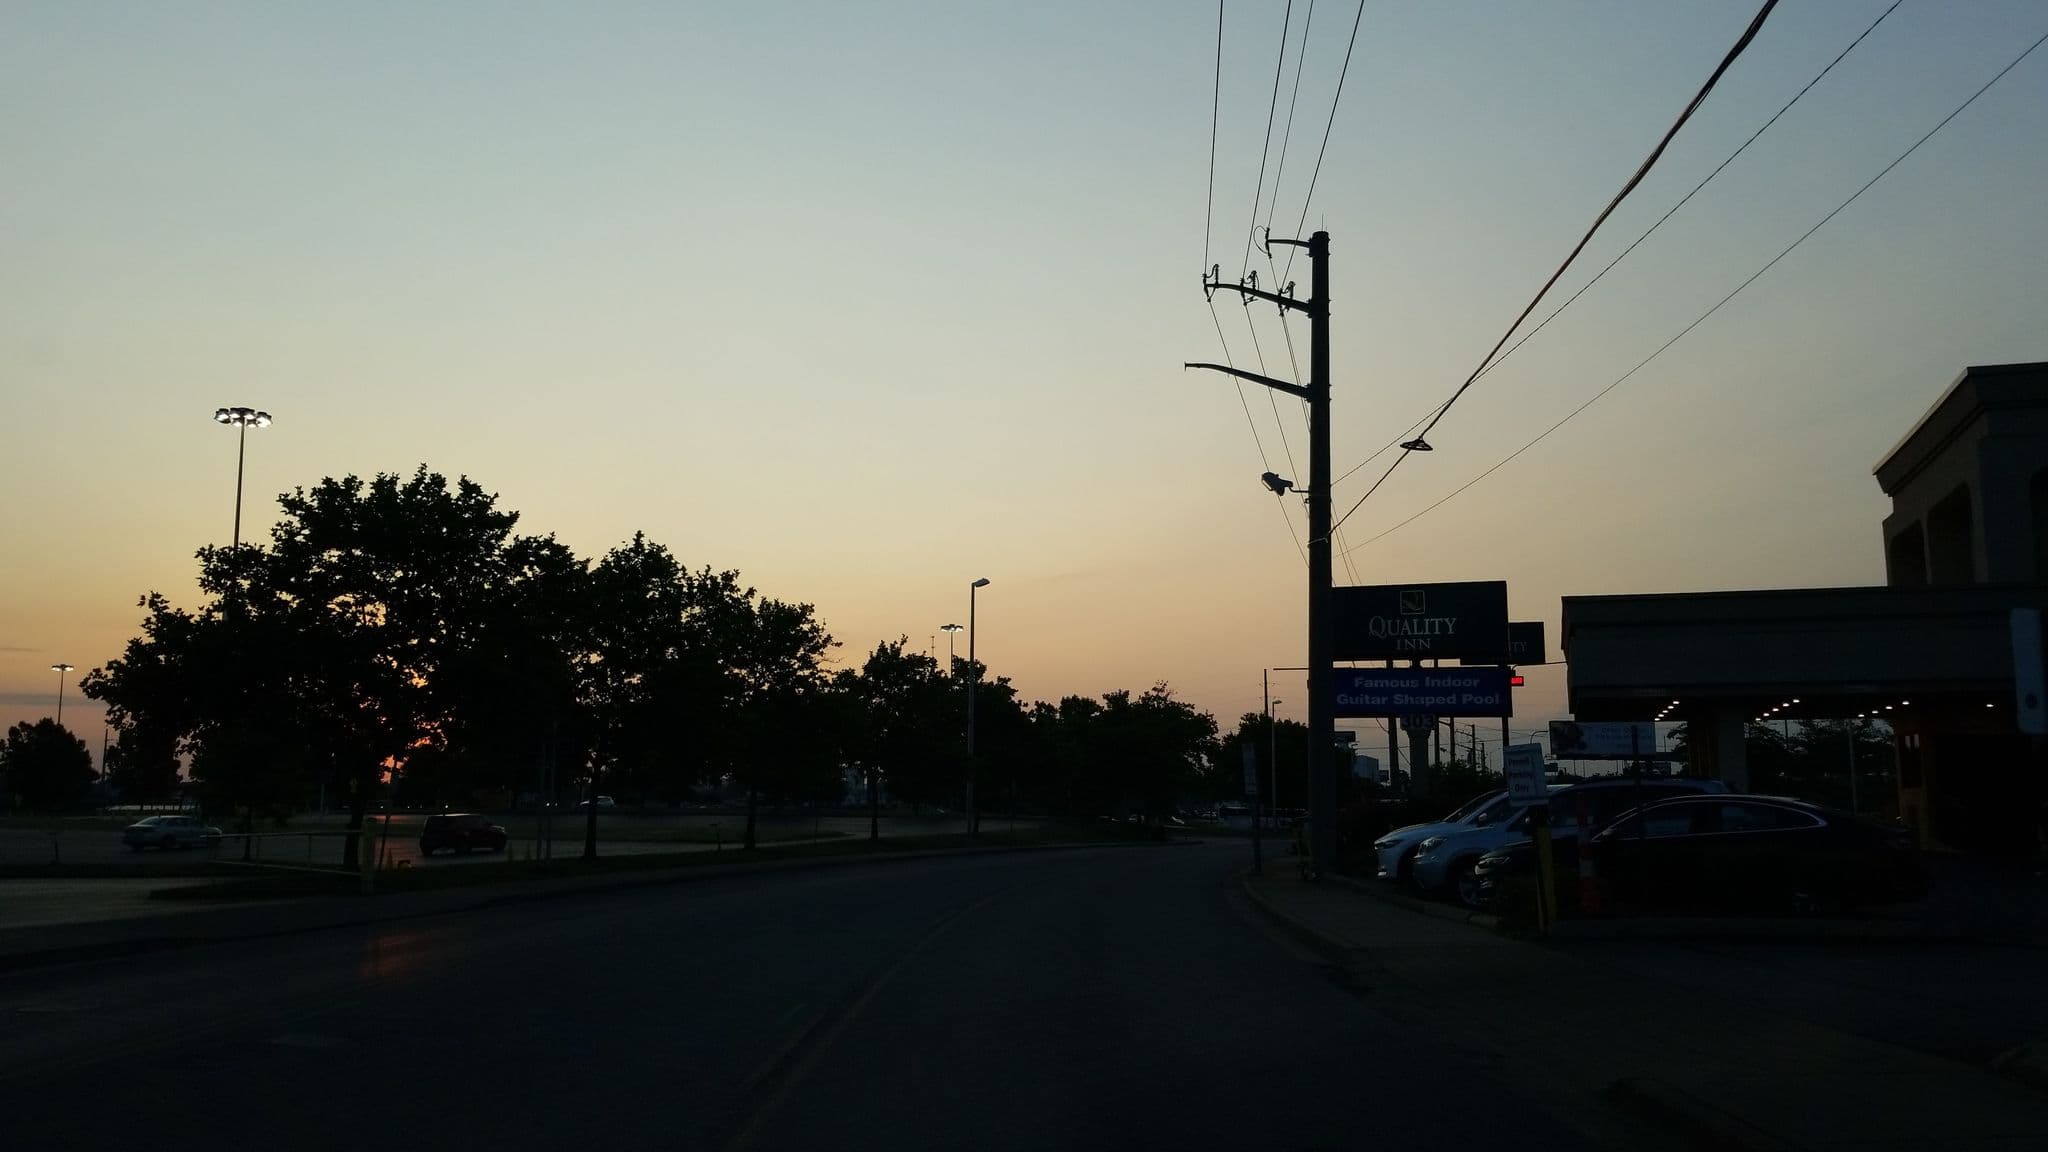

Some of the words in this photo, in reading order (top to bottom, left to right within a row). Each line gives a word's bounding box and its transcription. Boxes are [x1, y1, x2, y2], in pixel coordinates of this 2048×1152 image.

[1369, 616, 1457, 638] QUALITY
[1397, 638, 1431, 650] INN
[1353, 676, 1417, 689] Famous
[1425, 676, 1480, 688] Indoor
[1336, 693, 1388, 705] Guitar
[1393, 693, 1456, 707] Shaped
[1461, 693, 1500, 704] Pool
